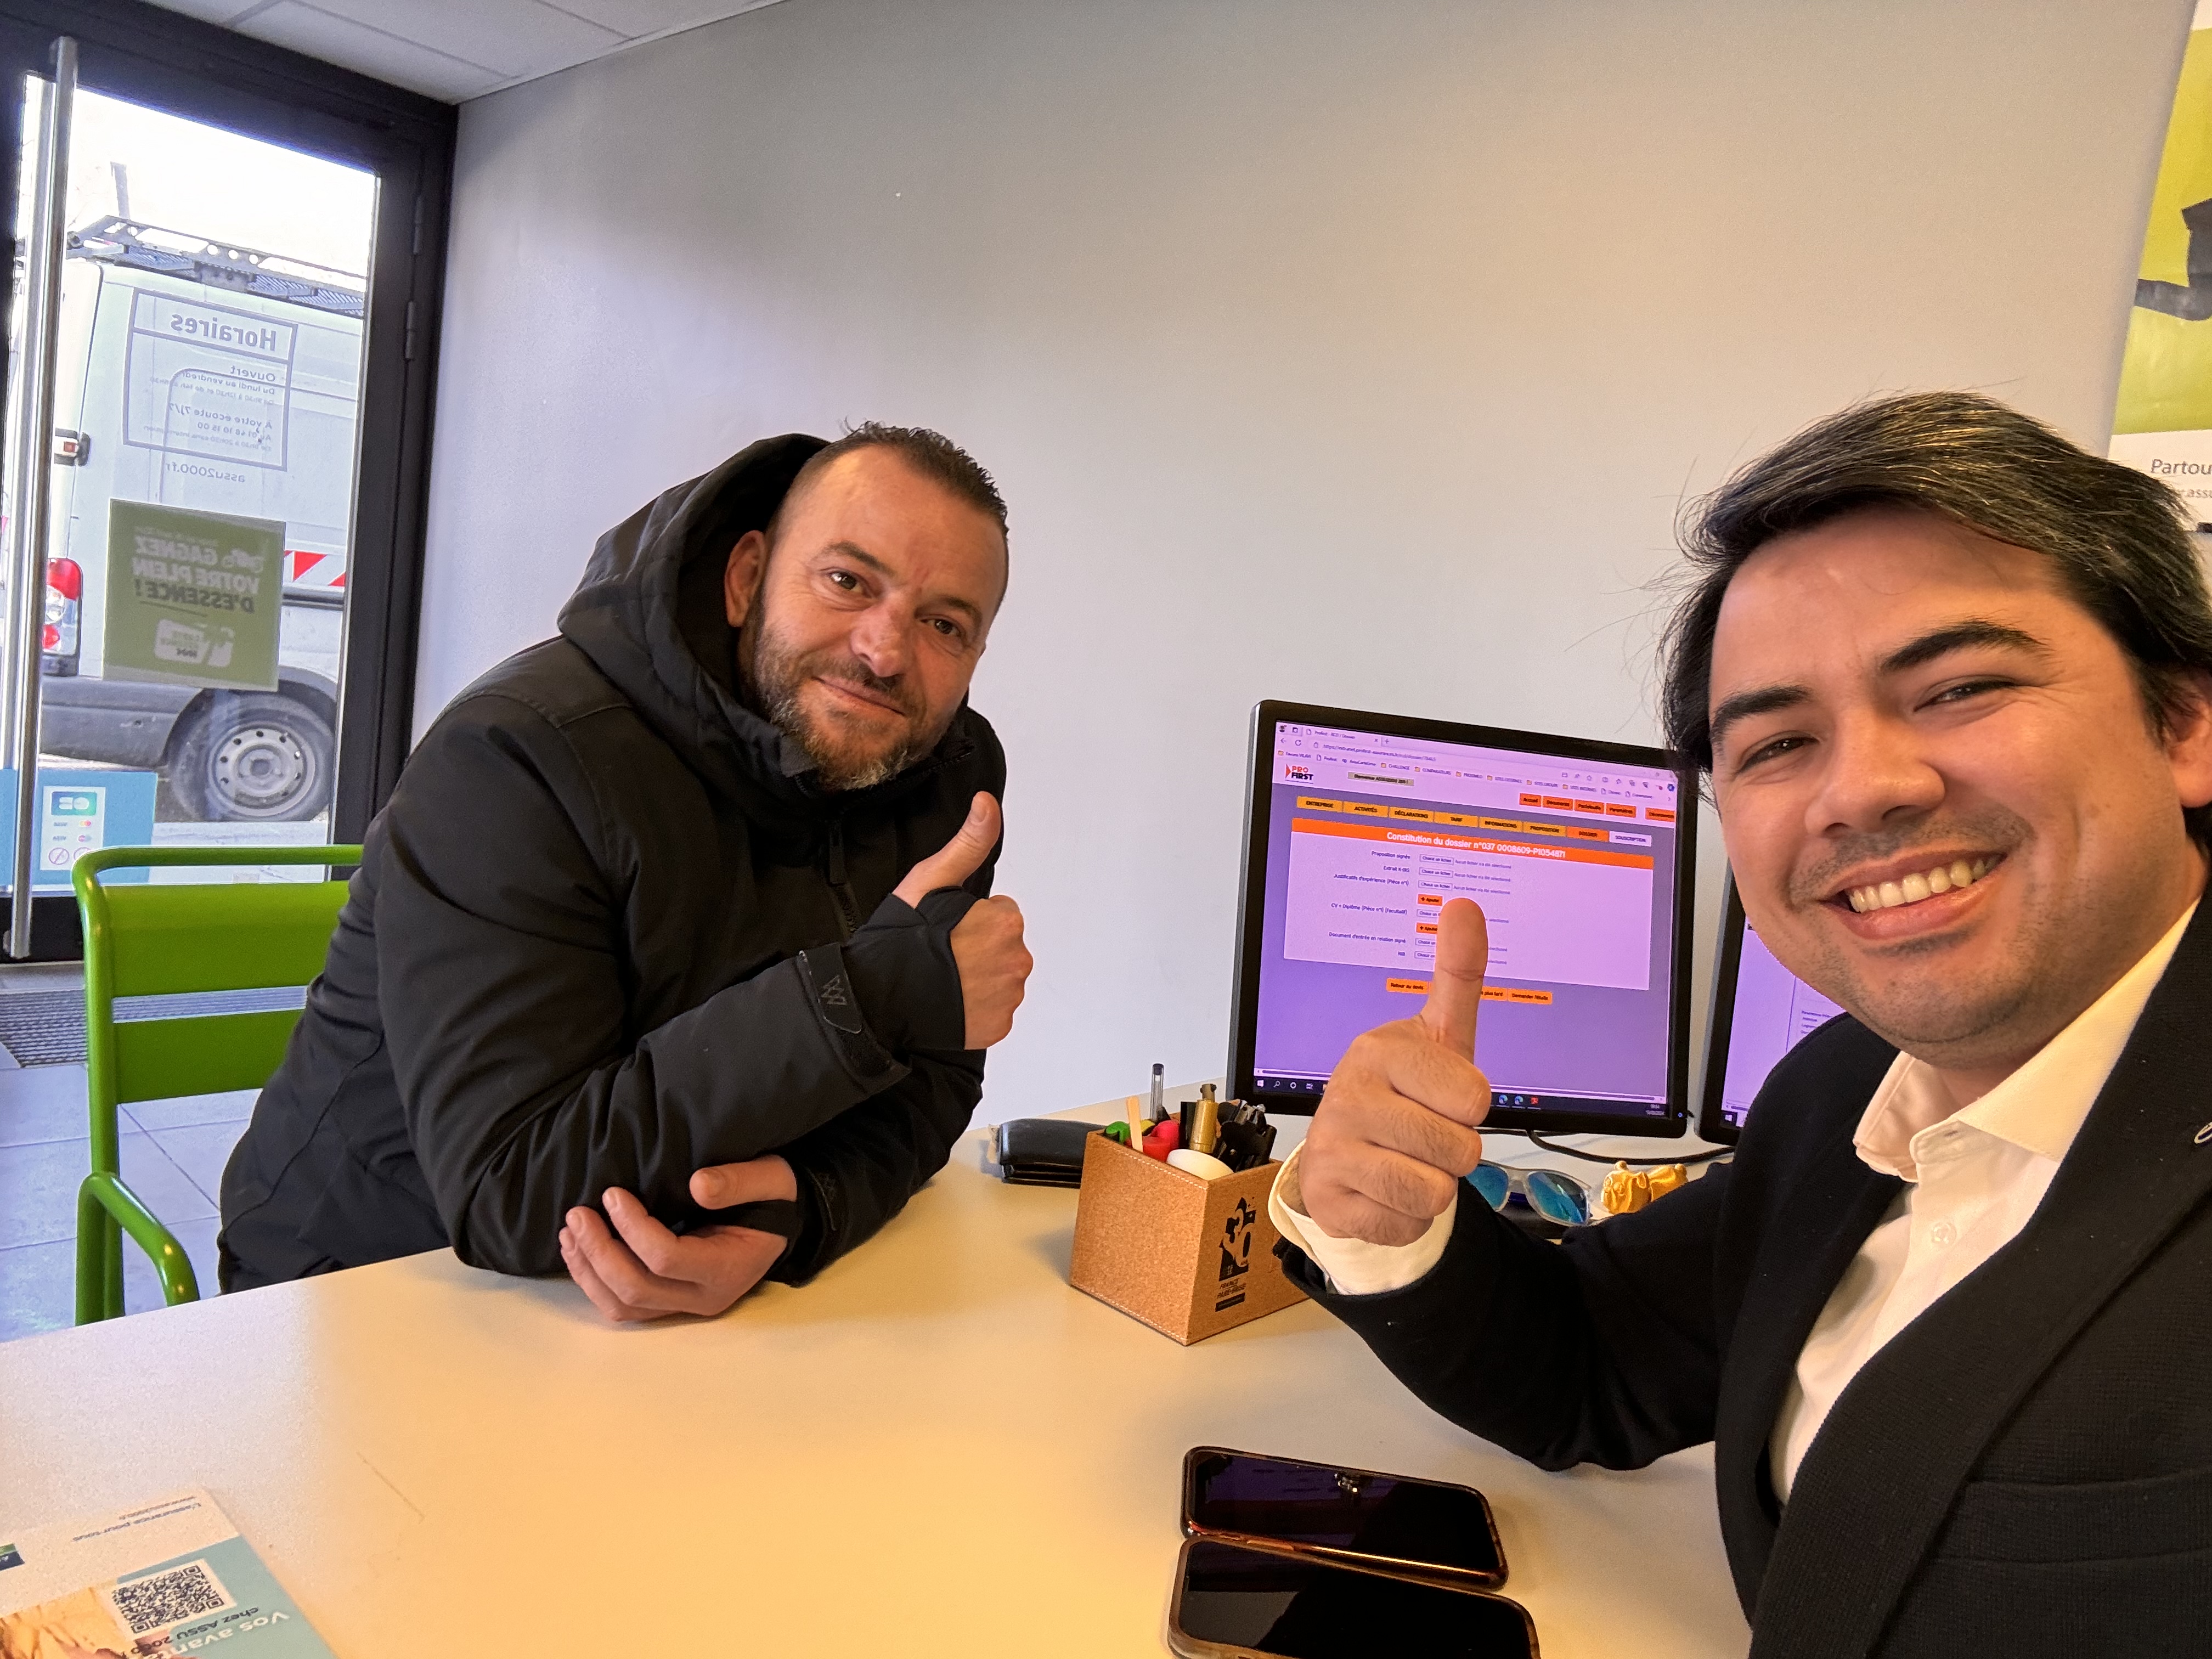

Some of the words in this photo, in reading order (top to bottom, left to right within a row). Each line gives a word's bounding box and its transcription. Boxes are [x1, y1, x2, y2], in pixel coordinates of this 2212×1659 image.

[1291, 765, 1309, 773] PRO
[1291, 772, 1314, 780] FIRST
[1306, 800, 1334, 808] ENTREPRISE
[1395, 809, 1428, 819] DÉCLARATIONS
[1386, 831, 1432, 845] Constitution
[1433, 837, 1443, 845] du
[1444, 838, 1471, 848] dossier
[1473, 842, 1496, 851] n°037
[223, 1606, 259, 1623] chez
[239, 1611, 290, 1632] Vos
[176, 1620, 218, 1640] ASSU
